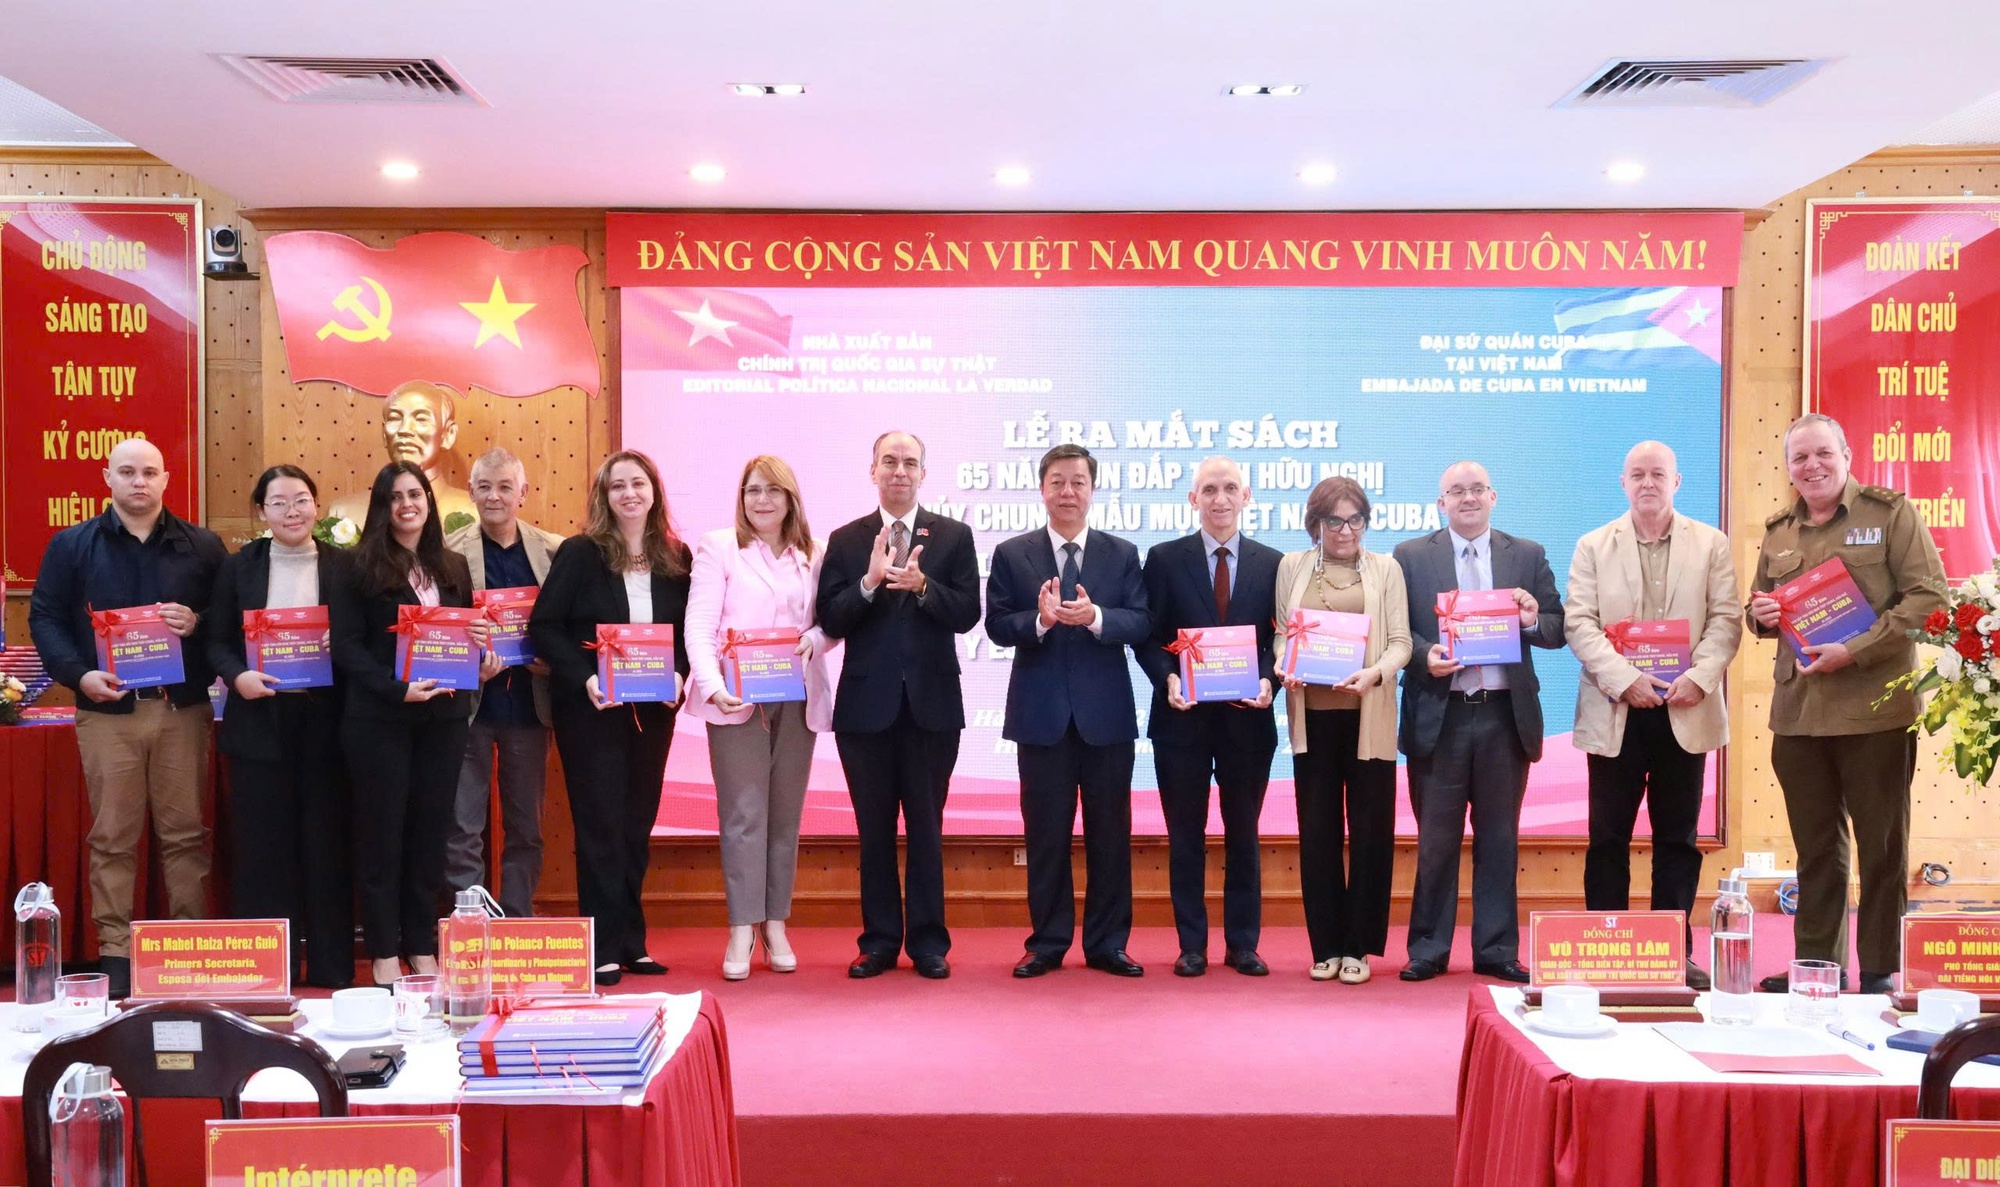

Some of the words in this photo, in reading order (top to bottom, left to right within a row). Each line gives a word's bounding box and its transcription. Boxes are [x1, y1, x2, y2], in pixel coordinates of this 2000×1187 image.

[42, 229, 83, 270] CHỦ
[89, 235, 146, 276] ĐỘNG
[637, 231, 753, 271] ĐẢNG
[765, 236, 882, 280] CỘNG
[894, 232, 971, 272] SẢN
[982, 236, 1078, 280] VIỆT
[1089, 240, 1182, 270] NAM
[1193, 240, 1341, 277] QUANG
[1350, 240, 1454, 270] VINH
[1464, 231, 1590, 271] MUÔN
[1600, 231, 1707, 270] NĂM!
[1865, 234, 1919, 271] ĐOÀN
[1926, 233, 1962, 271] KẾT
[45, 296, 102, 333] SÁNG
[108, 303, 148, 338] TẠO
[1871, 297, 1912, 332] DÂN
[1917, 291, 1957, 333] CHỦ
[802, 332, 840, 350] NHÀ
[845, 331, 891, 350] XUẤT
[1420, 335, 1450, 353] ĐẠI
[1454, 332, 1481, 350] SỨ
[1485, 331, 1534, 350] QUÁN
[1539, 335, 1587, 350] CUBA
[738, 354, 794, 371] CHÍNH
[798, 357, 826, 374] TRỊ
[832, 352, 881, 372] QUỐC
[885, 357, 916, 372] GIA
[920, 357, 947, 375] SỰ
[951, 353, 997, 375] THẬT
[1445, 357, 1474, 374] TẠI
[1479, 353, 1519, 374] VIỆT
[1523, 356, 1562, 371] NAM
[52, 360, 93, 401] TẬN
[98, 366, 136, 402] TỤY
[683, 378, 774, 393] EDITORIAL
[778, 374, 859, 393] POLÍTICA
[862, 378, 950, 393] NACIONAL
[955, 378, 979, 393] LA
[983, 378, 1053, 393] VERDAD
[1361, 378, 1455, 393] EMBAJADA
[1459, 378, 1482, 393] DE
[1486, 378, 1535, 393] CUBA
[1540, 378, 1564, 393] EN
[1568, 378, 1647, 393] VIETNAM
[1877, 361, 1908, 396] TRÍ
[1914, 360, 1949, 402] TUỆ
[1003, 410, 1050, 448] LỄ
[1059, 420, 1116, 448] RA
[1125, 409, 1219, 448] MẮT
[1227, 412, 1338, 448] SÁCH
[43, 419, 69, 460] KỶ
[76, 428, 146, 460] CƯƠ
[1873, 420, 1906, 462] ĐỔI
[1913, 427, 1951, 462] MỚI
[956, 462, 990, 490] 65
[1128, 452, 1182, 489] ĐẮP
[1258, 457, 1311, 490] HỮU
[975, 503, 1047, 531] CHUN
[1088, 492, 1141, 531] MẪU
[1238, 497, 1273, 536] IỆT
[1370, 503, 1441, 531] CUBA
[1810, 610, 1828, 623] NAM
[1831, 596, 1853, 611] CUBA
[126, 631, 139, 640] 65
[428, 631, 441, 640] 65
[1489, 624, 1509, 632] CUBA
[125, 646, 143, 655] NAM
[149, 643, 169, 652] CUBA
[275, 647, 293, 655] NAM
[299, 645, 320, 653] CUBA
[425, 645, 442, 653] NAM
[449, 646, 469, 655] CUBA
[1638, 645, 1650, 653] 65
[773, 662, 792, 670] CUBA
[1229, 660, 1248, 668] CUBA
[1659, 658, 1679, 666] CUBA
[1605, 917, 1618, 928] ST
[1958, 923, 1989, 936] ĐỒNG
[1583, 926, 1613, 938] ĐỒNG
[1615, 928, 1633, 938] CHÍ
[141, 938, 161, 951] Mrs
[163, 937, 194, 951] Mabel
[196, 937, 223, 950] Raiza
[225, 936, 253, 950] Pérez
[255, 935, 278, 949] Guió
[504, 937, 543, 950] Polanco
[546, 936, 584, 950] Fuentes
[1549, 941, 1572, 956] VŨ
[1577, 942, 1632, 958] TRỌNG
[1636, 940, 1670, 956] LÂM
[1923, 939, 1956, 955] NGÔ
[1961, 941, 2000, 955] MINH
[164, 959, 202, 969] Primera
[527, 960, 532, 968] y
[1944, 962, 1960, 971] PHÓ
[1962, 960, 1983, 971] TỔNG
[158, 974, 192, 985] Esposa
[194, 974, 210, 984] del
[212, 973, 263, 985] Embajador
[547, 973, 574, 982] Vietnam
[1954, 972, 1976, 983] TIẾNG
[1978, 973, 1993, 983] NÓI
[1940, 1157, 1971, 1184] ĐẠI
